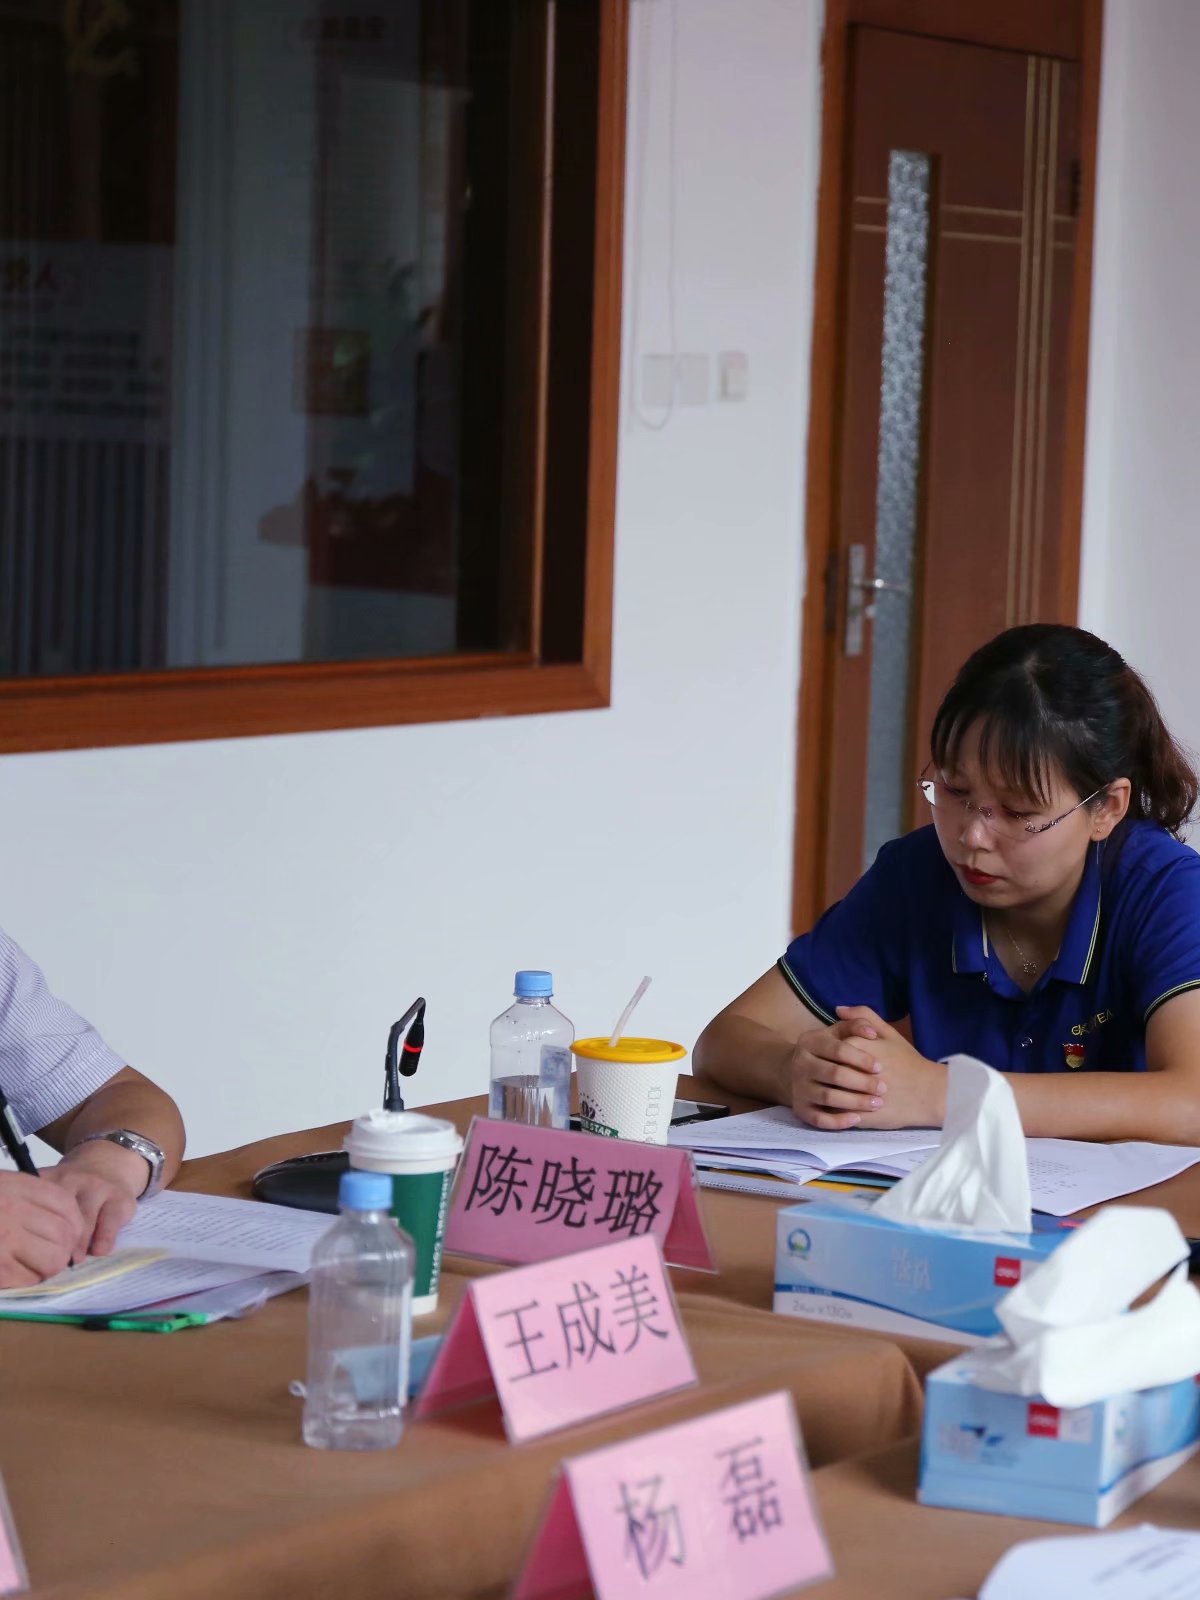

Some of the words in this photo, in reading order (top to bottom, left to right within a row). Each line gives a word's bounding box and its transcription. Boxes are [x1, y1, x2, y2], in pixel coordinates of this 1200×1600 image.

[463, 1143, 665, 1238] 陈晓璐
[493, 1264, 671, 1384] 王成美
